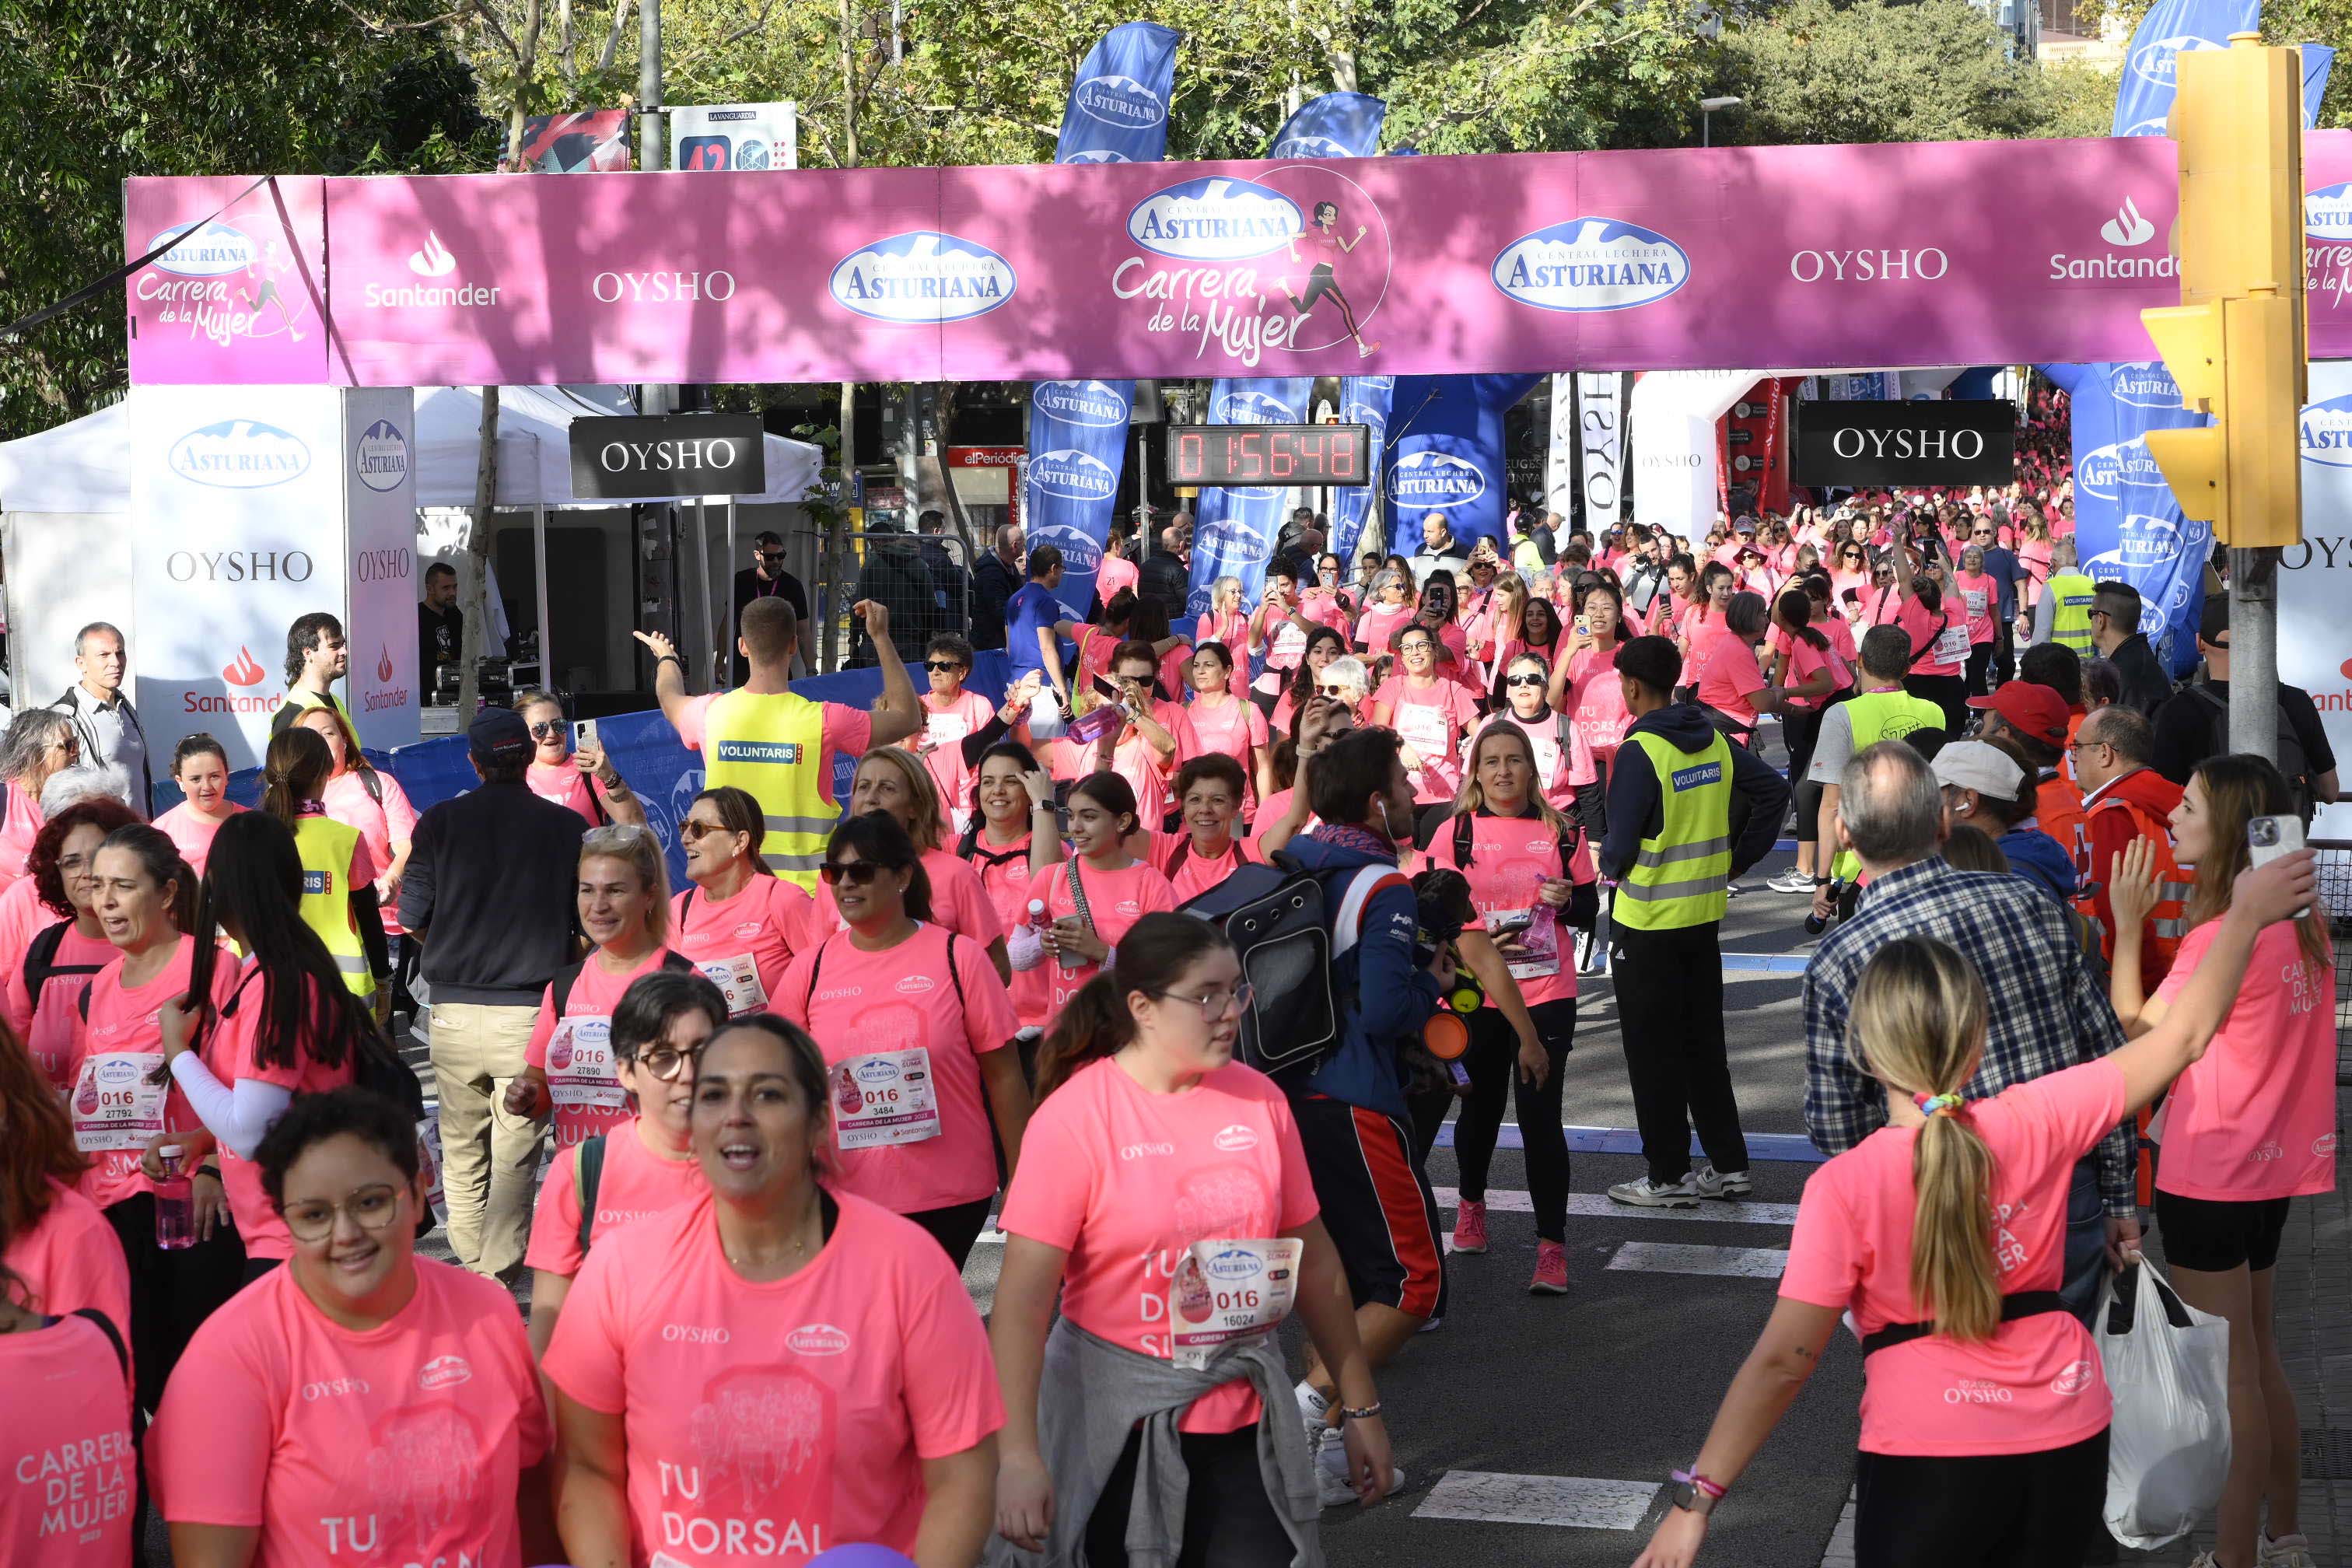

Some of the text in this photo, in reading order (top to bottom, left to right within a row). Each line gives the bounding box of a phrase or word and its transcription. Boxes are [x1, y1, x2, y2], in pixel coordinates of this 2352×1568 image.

[1082, 87, 1157, 121] ASTURIANA
[1140, 208, 1291, 240] ASTURIANA
[1537, 249, 1668, 261] CENTRAL LECHERA
[1790, 248, 1948, 282] OYSHO
[1112, 257, 1258, 299] Carrera
[1507, 254, 1675, 289] ASTURIANA
[137, 273, 229, 301] Carrera
[593, 271, 735, 303] OYSHO
[845, 266, 1003, 299] ASTURIANA
[365, 283, 500, 306] Santander
[159, 297, 261, 347] de la Mujer
[1148, 295, 1312, 367] de la Mujer
[2114, 373, 2182, 396] ASTURIA
[1041, 388, 1120, 419] ASTURIANA
[1833, 428, 1984, 460] OYSHO
[180, 446, 301, 473] ASTURIANA
[360, 447, 405, 474] ASTURIANA
[601, 439, 736, 472] OYSHO
[1034, 463, 1110, 493] ASTURIANA
[1399, 470, 1475, 479] CENTRAL LECHERA
[1390, 476, 1478, 495] ASTURIANA
[166, 551, 313, 583] OYSHO
[358, 548, 410, 583] OYSHO
[1107, 576, 1116, 586] 21
[365, 687, 408, 713] Santander
[1580, 706, 1595, 717] TU
[719, 744, 793, 759] VOLUNTARIS
[821, 986, 862, 1001] OYSHO
[575, 1049, 604, 1063] 016
[101, 1069, 135, 1078] ASTURIANA
[577, 1066, 600, 1076] 27890
[859, 1069, 896, 1079] ASTURIANA
[102, 1091, 134, 1105] 016
[553, 1089, 583, 1098] OYSHO
[604, 1091, 621, 1100] Santan
[865, 1088, 899, 1104] 016
[105, 1109, 133, 1118] 27792
[873, 1106, 894, 1115] 3484
[81, 1136, 113, 1145] OYSHO
[555, 1125, 601, 1146] SUM
[847, 1132, 877, 1142] OYSHO
[901, 1125, 933, 1135] Santander
[1121, 1143, 1174, 1161] OYSHO
[1212, 1263, 1258, 1274] ASTURIANA
[1216, 1290, 1259, 1310] 016
[1223, 1314, 1255, 1327] 16024
[662, 1324, 730, 1345] OYSHO
[1189, 1334, 1225, 1344] CARRERA
[303, 1379, 370, 1403] OYSHO
[1944, 1388, 2014, 1404] OYSHO
[46, 1463, 126, 1507] DE LA
[657, 1459, 699, 1500] TU
[38, 1489, 128, 1538] MUJER
[320, 1514, 378, 1556] TU
[662, 1511, 825, 1556] DORSAL
